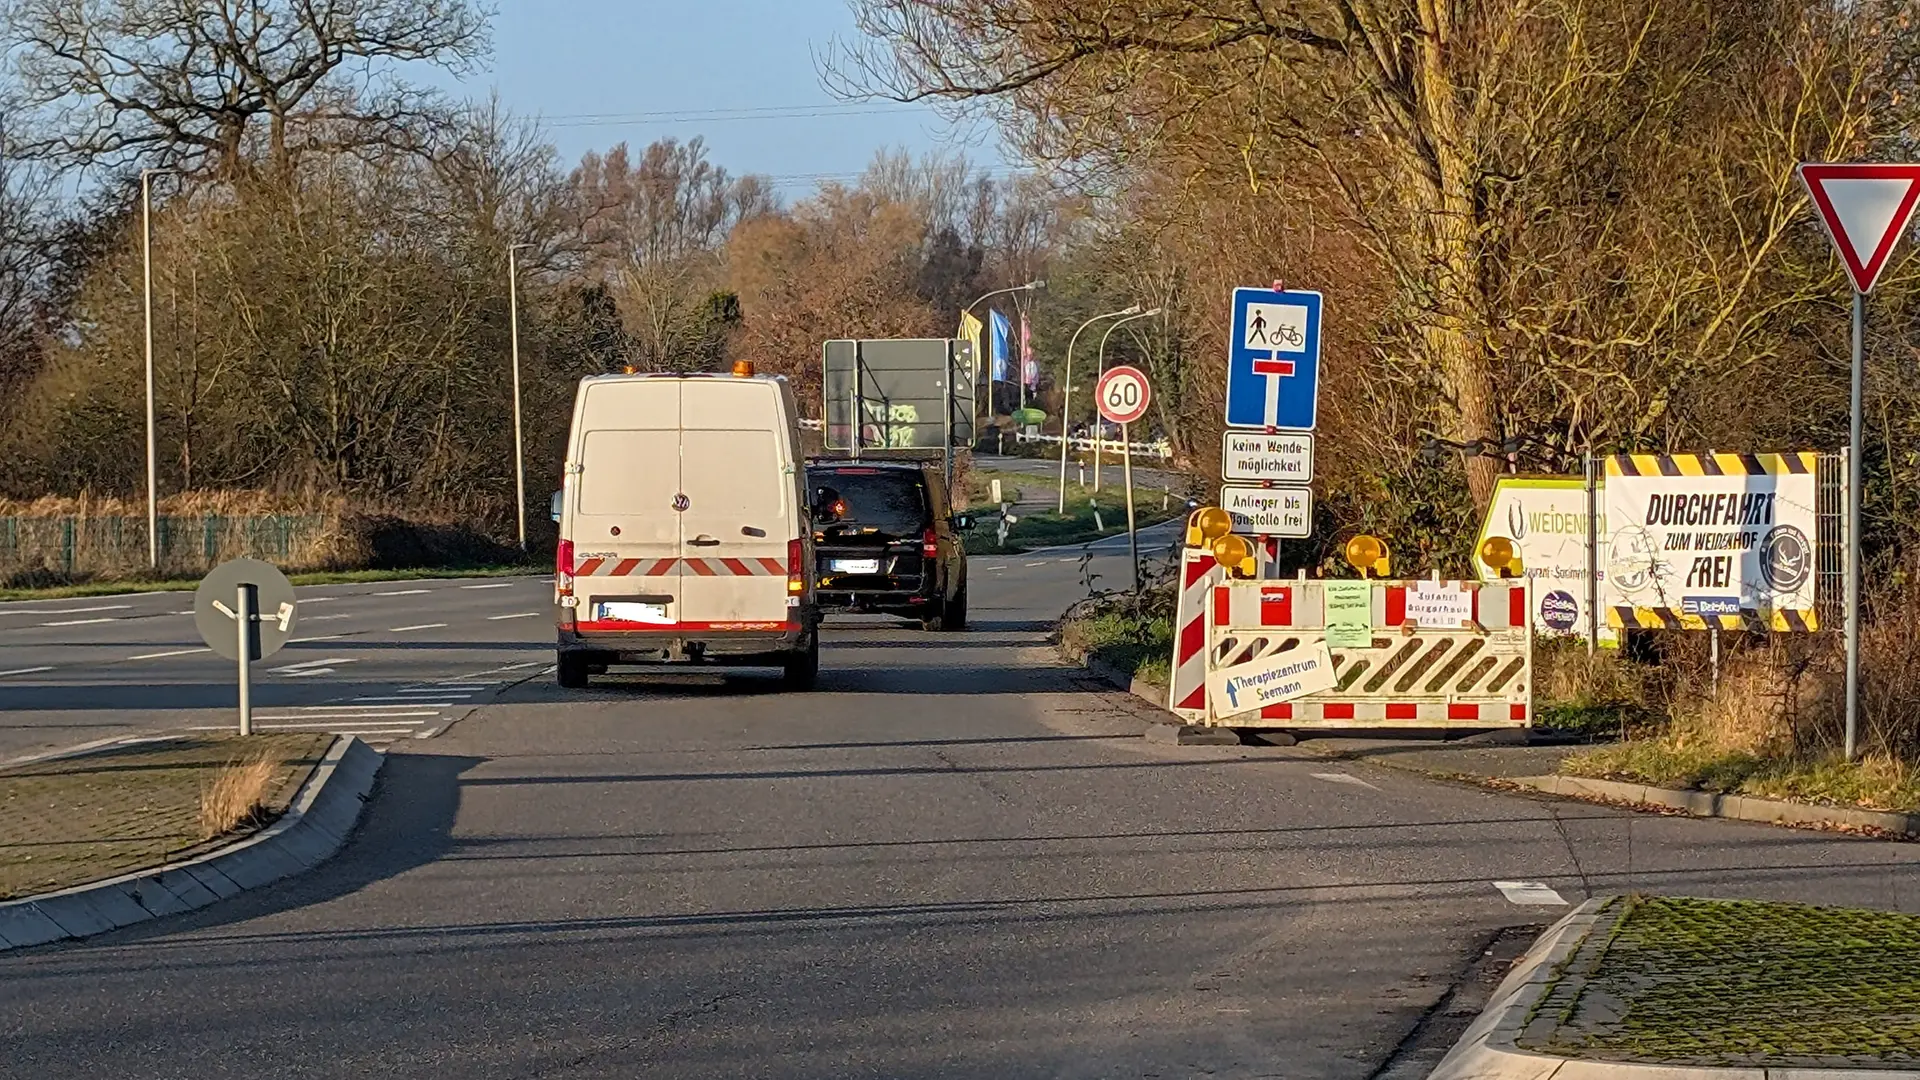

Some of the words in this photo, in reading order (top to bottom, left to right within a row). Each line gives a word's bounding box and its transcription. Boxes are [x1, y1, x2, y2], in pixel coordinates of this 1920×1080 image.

[1109, 382, 1137, 407] 60
[1232, 438, 1261, 452] keine
[1238, 457, 1301, 474] möglichkeit
[1233, 495, 1278, 511] Anlieger
[1284, 496, 1300, 509] bis
[1646, 492, 1776, 526] DURCHFAHRT
[1284, 512, 1302, 526] frei
[1664, 531, 1691, 551] ZUM
[1694, 531, 1759, 551] WEIDENHOF
[1686, 556, 1732, 588] FREI
[1233, 659, 1317, 690] Therapiezentrum
[1256, 681, 1302, 701] Seemann
